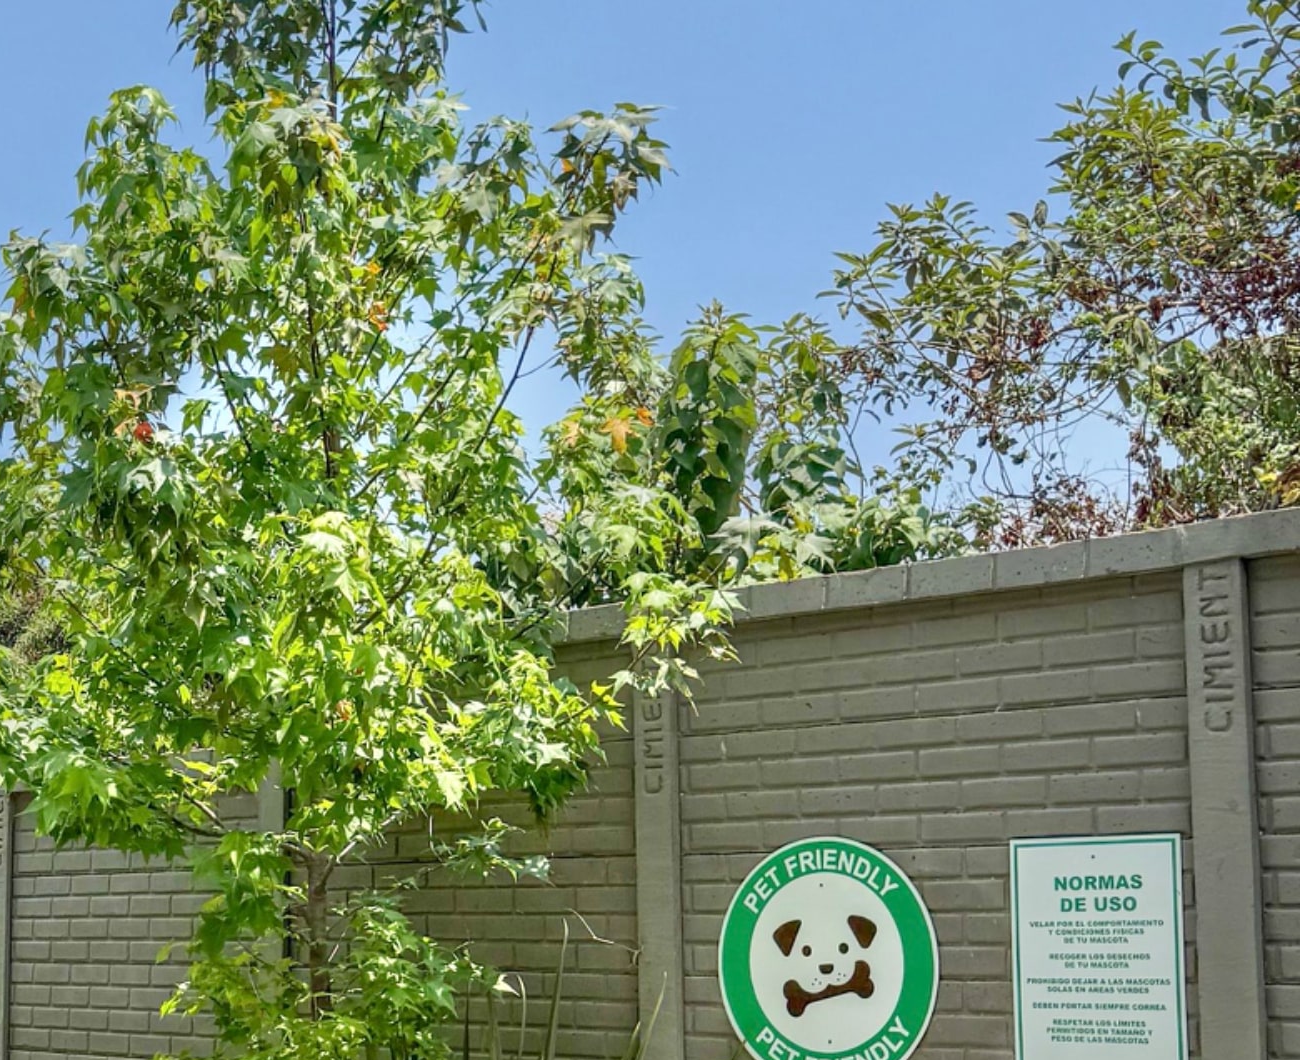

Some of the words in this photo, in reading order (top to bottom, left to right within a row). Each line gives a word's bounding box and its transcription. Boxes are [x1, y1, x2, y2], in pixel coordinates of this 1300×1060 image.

[1198, 567, 1235, 732] CIMIENT
[642, 656, 664, 794] CIMIE
[743, 867, 781, 914] PET
[784, 849, 900, 898] FRIENDLY
[1054, 874, 1143, 891] NORMAS
[1060, 897, 1087, 912] DE
[1094, 896, 1137, 912] USO
[1087, 919, 1165, 927] COMPORTAMIENTO
